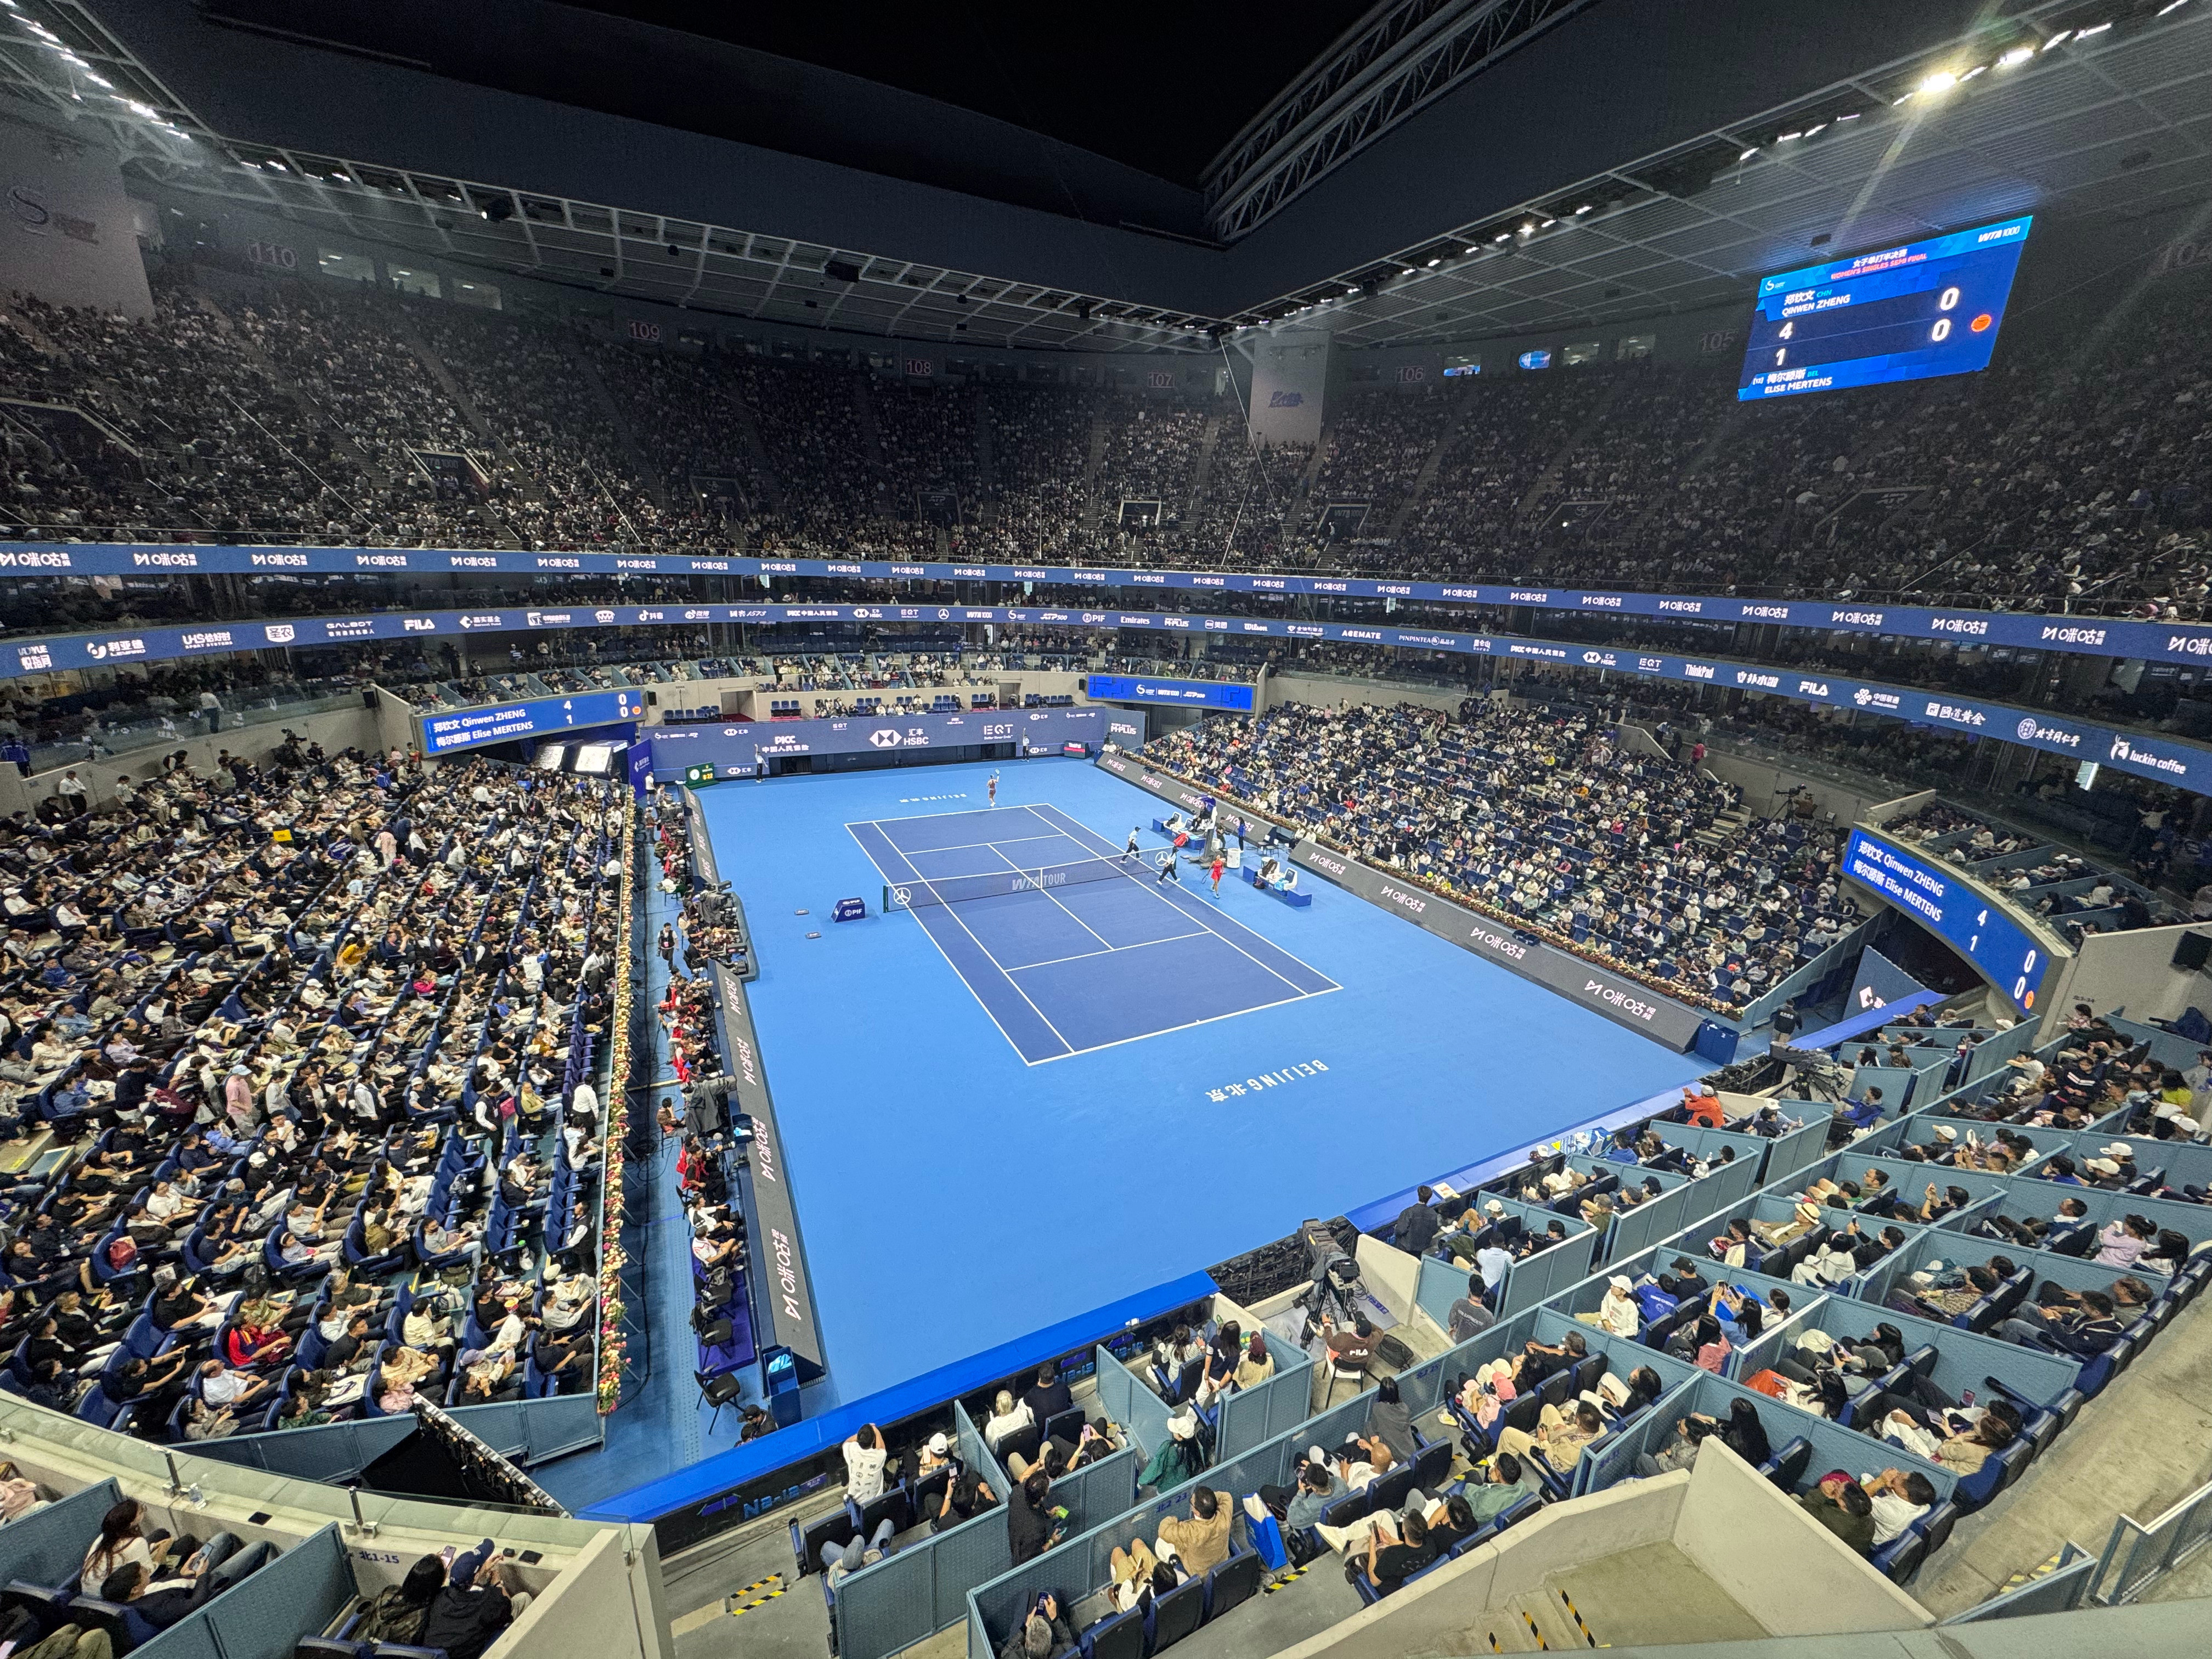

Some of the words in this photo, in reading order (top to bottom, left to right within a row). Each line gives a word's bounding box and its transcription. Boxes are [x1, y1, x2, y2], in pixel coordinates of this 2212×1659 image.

[1978, 229, 2002, 242] WTA
[2001, 225, 2021, 237] 1000
[1862, 262, 1889, 274] SINGLES
[1890, 257, 1907, 267] SEMI
[1908, 253, 1927, 264] FINAL
[1782, 303, 1815, 317] QINWEN
[1816, 294, 1850, 309] ZHENG
[1939, 287, 1960, 311] 0
[630, 323, 660, 340] 109
[1779, 322, 1793, 340] 4
[1932, 319, 1951, 341] 0
[1776, 348, 1786, 366] 1
[907, 360, 932, 374] 108
[1398, 367, 1424, 381] 106
[1149, 373, 1172, 386] 107
[1764, 385, 1786, 394] ELISE
[1787, 377, 1832, 391] MERTENS
[404, 619, 435, 630] FILA
[1120, 616, 1150, 625] Emirates
[1244, 623, 1268, 631] Wilson
[269, 627, 292, 638] 圣农
[1398, 635, 1431, 644] PINPINTEA
[107, 640, 144, 651] 利亚德
[1525, 646, 1566, 657] 中国人民保险
[1639, 658, 1662, 668] EQT
[1685, 664, 1714, 679] ThinkPad
[1799, 681, 1829, 696] FILA
[461, 715, 494, 727] Qinwen
[495, 709, 526, 721] ZHENG
[564, 701, 572, 710] 4
[619, 693, 627, 705] 0
[472, 730, 492, 739] Elise
[493, 721, 534, 736] MERTENS
[566, 714, 573, 724] 1
[620, 706, 629, 718] 0
[984, 724, 1014, 735] EQT
[775, 735, 795, 744] PICC
[909, 728, 924, 736] 汇丰
[2035, 729, 2080, 747] 北京同仁堂
[761, 744, 809, 753] 中国人民保险
[904, 737, 929, 746] HSBC
[2129, 751, 2157, 766] luckin
[2157, 759, 2186, 775] coffee
[1043, 872, 1066, 885] TOUR
[1858, 840, 1884, 862] 郑钦文
[1884, 854, 1914, 879] Qinwen
[1913, 870, 1944, 897] ZHENG
[1977, 909, 1988, 927] 4
[2024, 950, 2036, 973] 0
[1885, 877, 1903, 896] Elise
[1903, 888, 1943, 922] MERTENS
[1970, 935, 1978, 952] 1
[2014, 976, 2025, 1000] 0
[1485, 934, 1526, 960] 咪咕视频
[1603, 989, 1656, 1021] 咪咕视频
[1246, 1059, 1329, 1091] BEIJING
[1205, 1084, 1247, 1102] 北京
[771, 1228, 795, 1293] 咪咕视频
[359, 1551, 399, 1564] 北1-15
